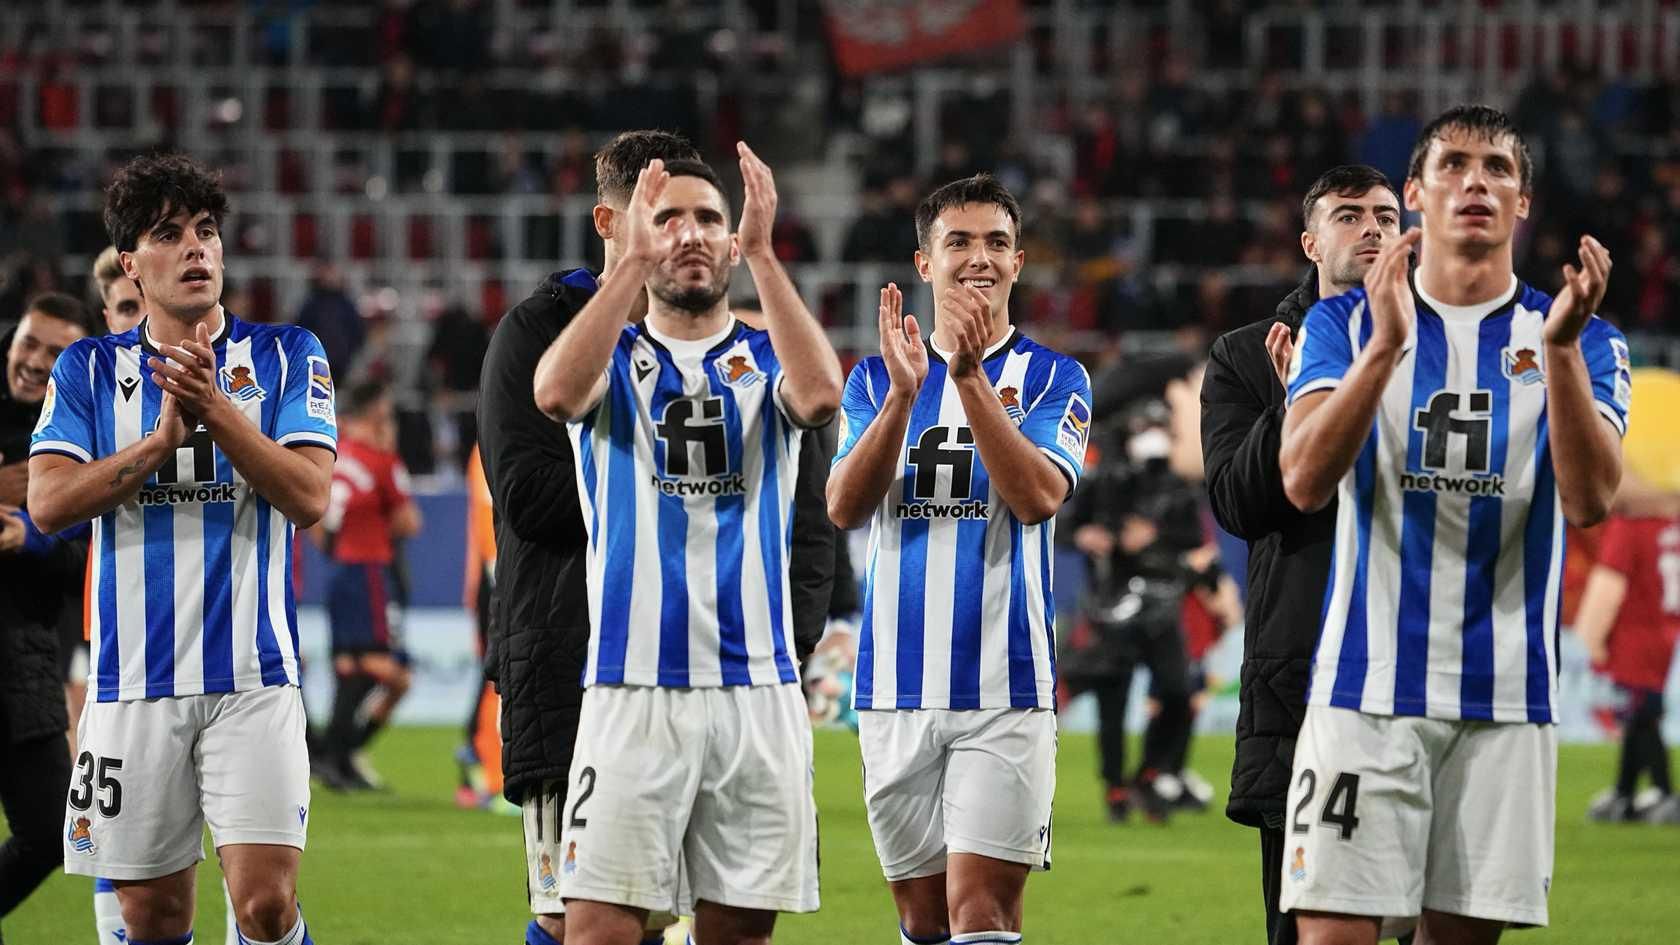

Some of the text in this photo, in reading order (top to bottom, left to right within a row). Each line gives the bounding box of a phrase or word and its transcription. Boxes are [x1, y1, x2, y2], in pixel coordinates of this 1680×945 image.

[655, 398, 727, 477] fi
[908, 425, 976, 500] fi
[1415, 391, 1491, 472] fi
[138, 483, 237, 505] network
[651, 473, 746, 496] network
[896, 501, 990, 519] network
[1400, 473, 1504, 495] network
[69, 750, 123, 819] 35
[570, 765, 597, 829] 2
[1293, 768, 1360, 841] 24
